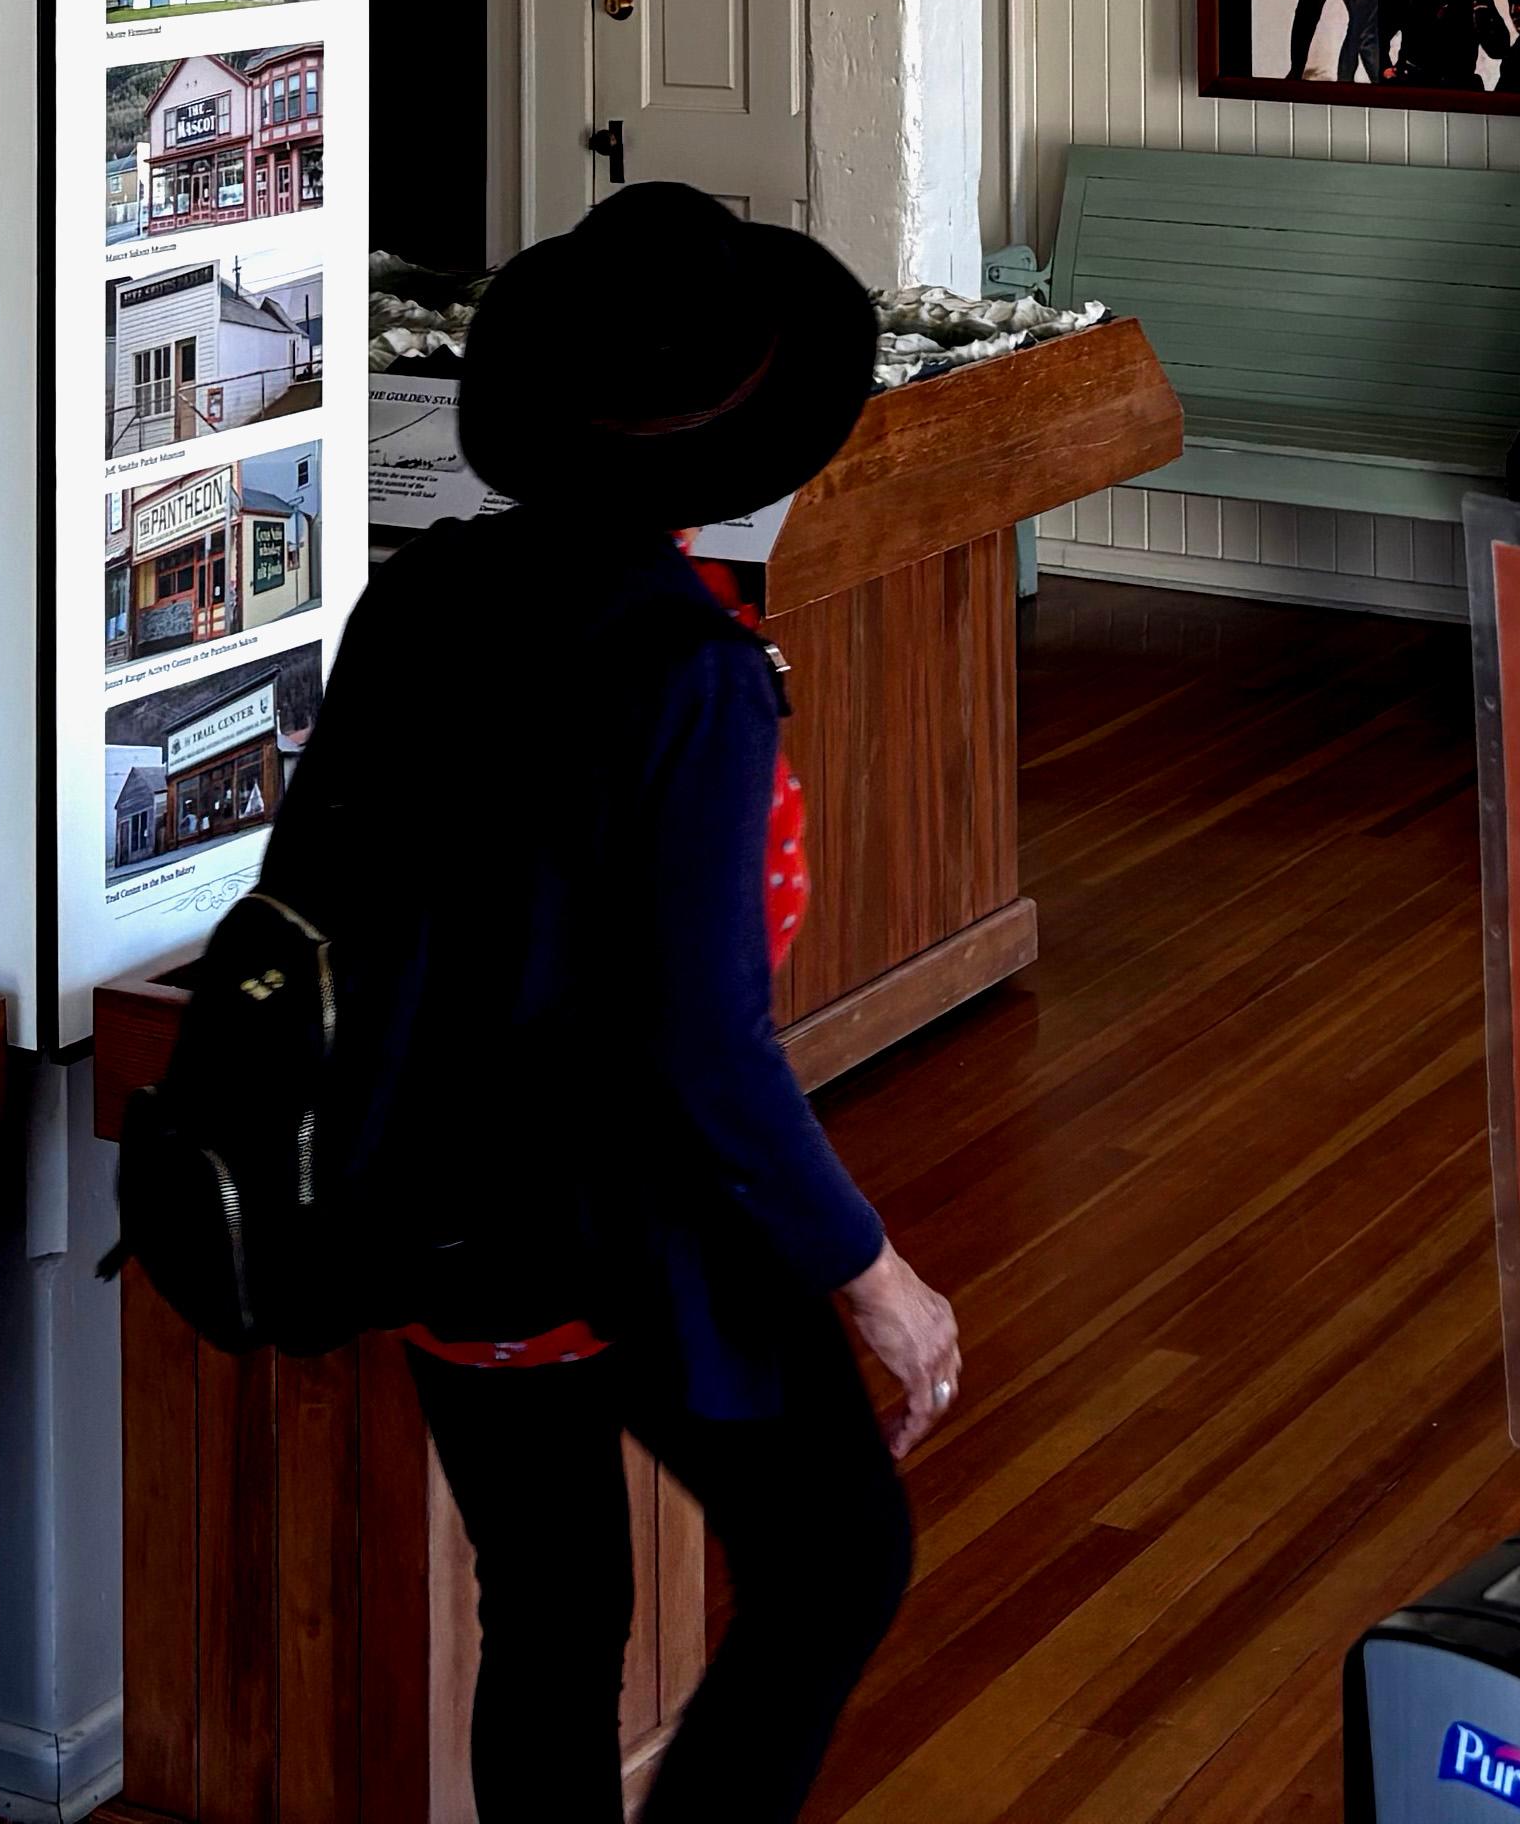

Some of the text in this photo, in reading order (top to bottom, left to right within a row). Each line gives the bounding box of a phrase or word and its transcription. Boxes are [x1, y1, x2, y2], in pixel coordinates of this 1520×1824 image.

[177, 115, 215, 138] MASCOT
[386, 392, 431, 404] GOLDEN
[151, 475, 223, 536] PANTHEON
[193, 704, 255, 743] TRAIL CENTER
